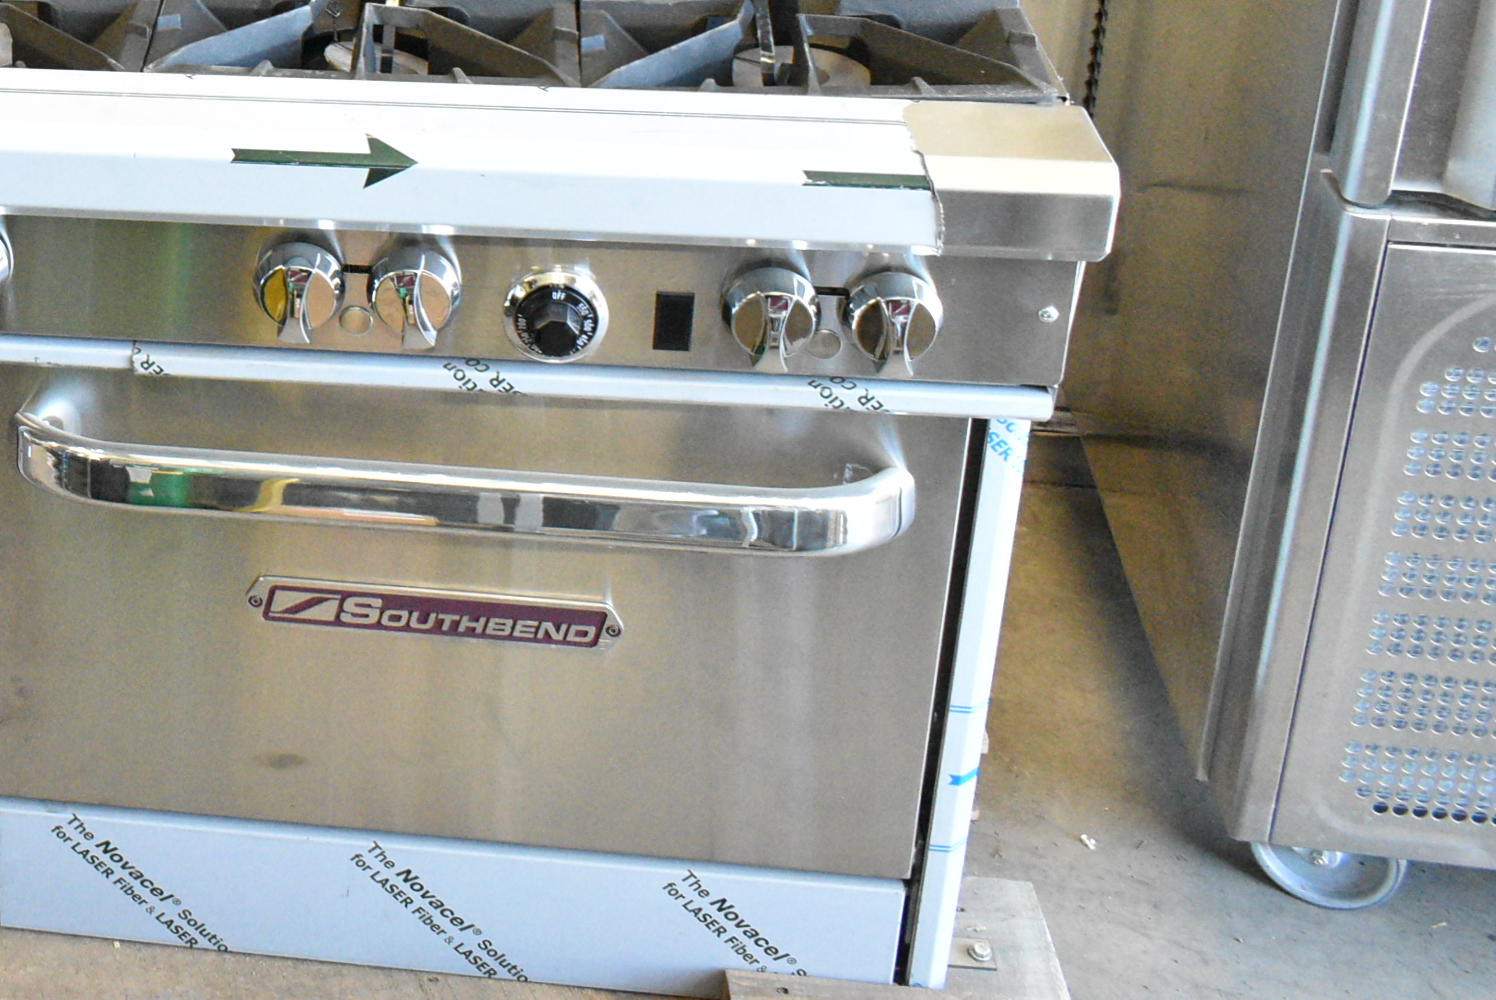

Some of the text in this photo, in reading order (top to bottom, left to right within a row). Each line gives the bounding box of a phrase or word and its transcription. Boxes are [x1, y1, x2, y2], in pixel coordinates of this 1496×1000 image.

[338, 595, 598, 643] SOUTHBEND
[50, 824, 199, 949] for LASER Fiber LASER
[67, 813, 95, 841] The
[177, 908, 229, 953] Solutio
[349, 853, 498, 979] for LASER Fiber LASER
[367, 840, 396, 870] The
[477, 939, 529, 983] Solutio
[661, 882, 761, 965] for LASER Fiber
[681, 869, 711, 899] The
